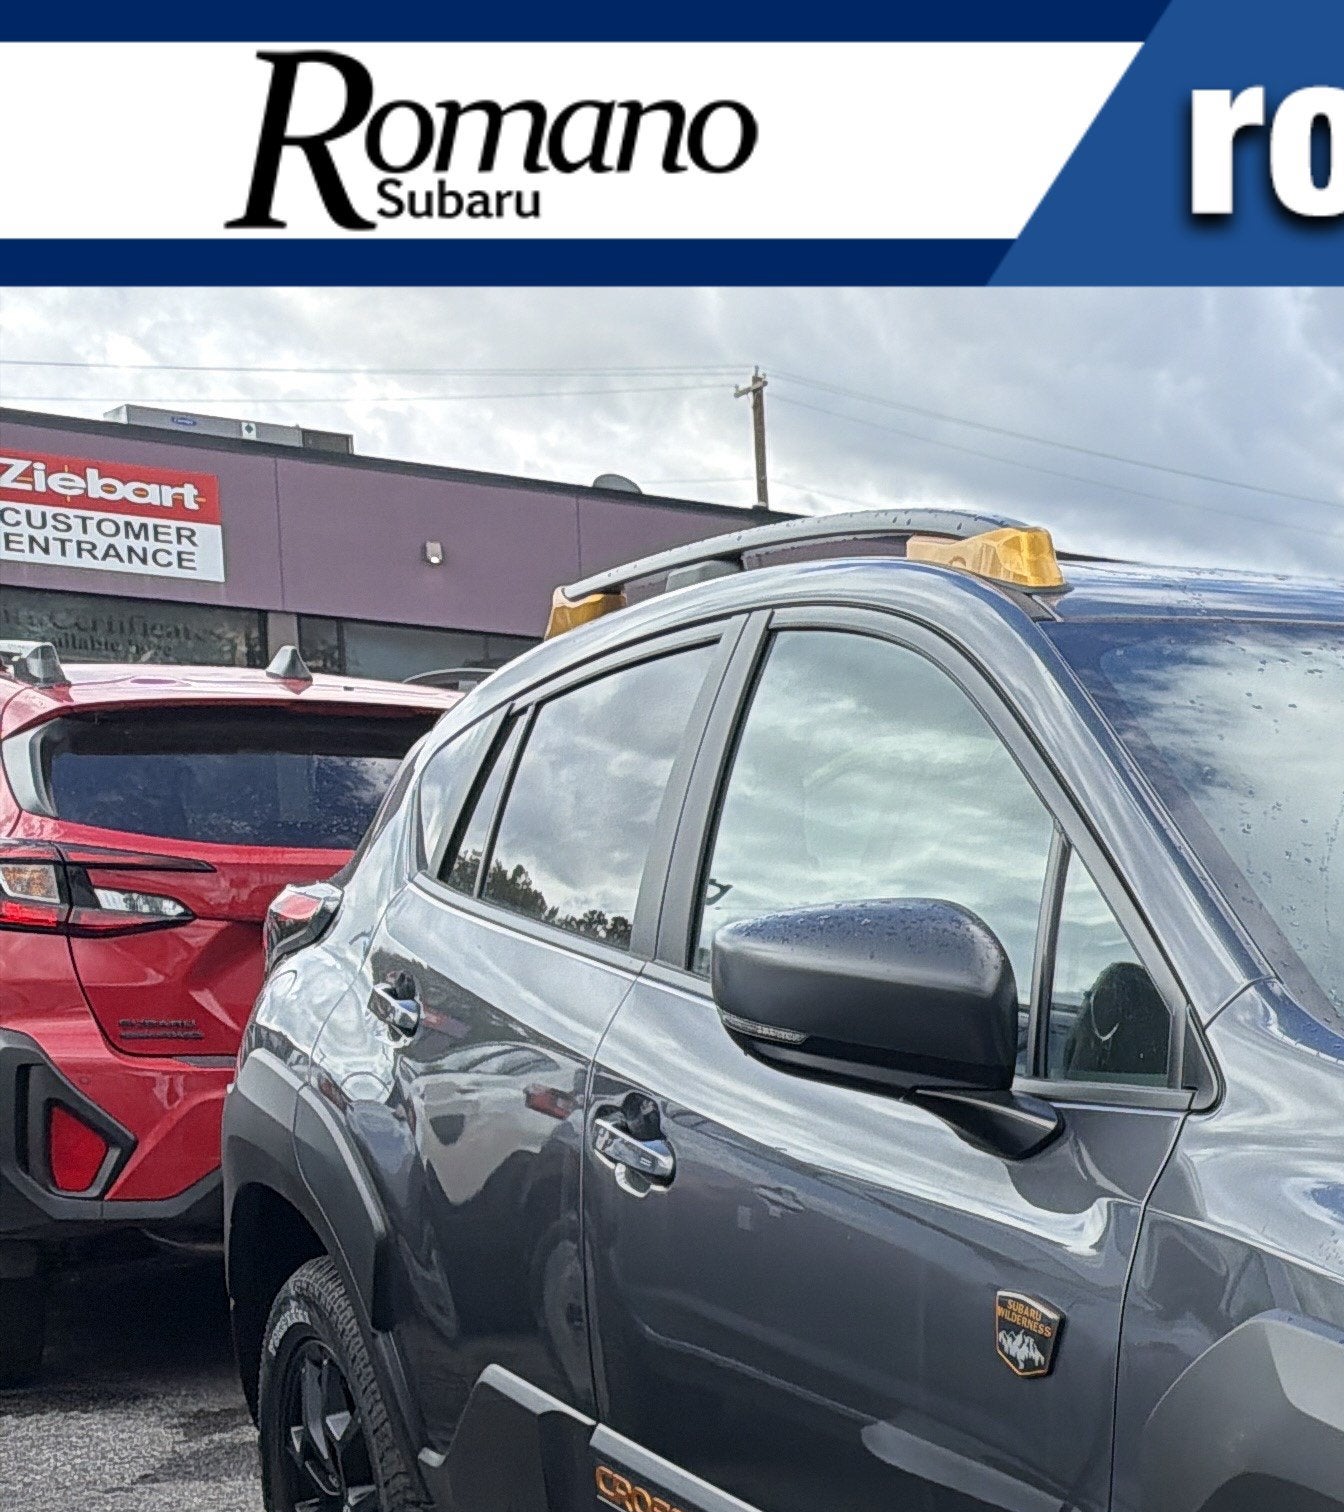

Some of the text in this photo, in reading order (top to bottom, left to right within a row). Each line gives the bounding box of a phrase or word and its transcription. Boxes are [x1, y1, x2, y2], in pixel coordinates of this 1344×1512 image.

[0, 456, 203, 510] Ziebart
[0, 507, 199, 548] CUSTOMER
[4, 532, 198, 572] ENTRANCE
[997, 1305, 1052, 1338] WILDERNESS
[1006, 1299, 1042, 1322] SUBARU
